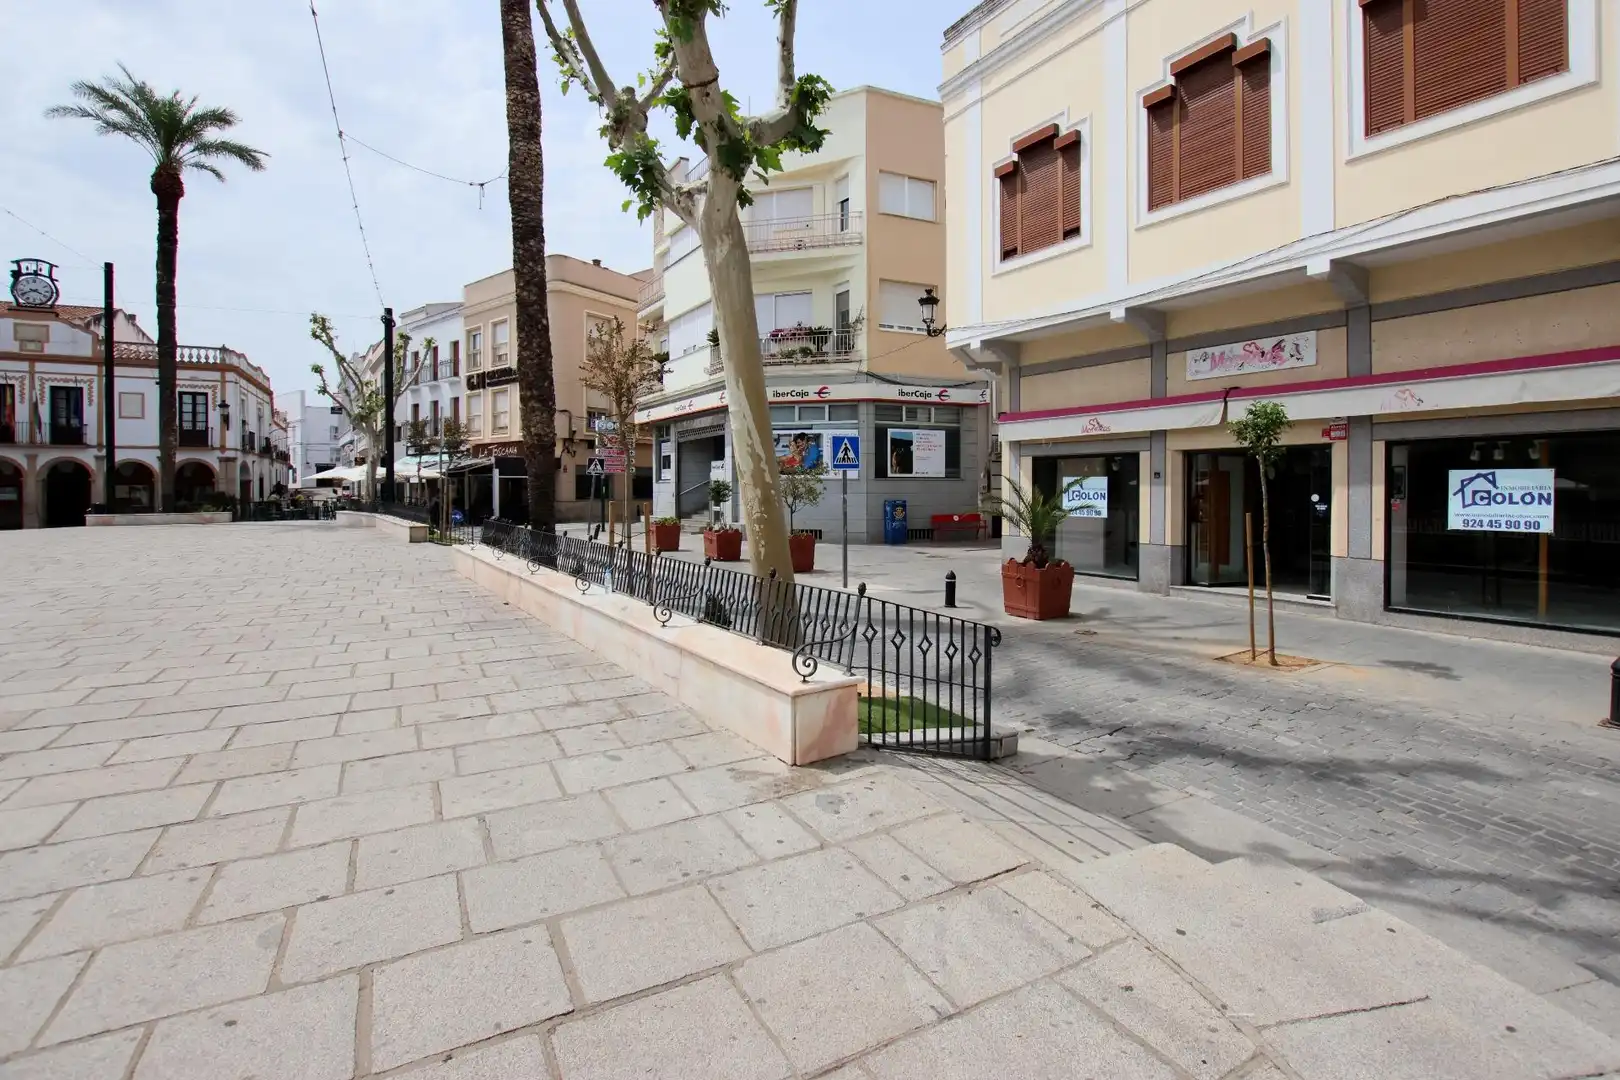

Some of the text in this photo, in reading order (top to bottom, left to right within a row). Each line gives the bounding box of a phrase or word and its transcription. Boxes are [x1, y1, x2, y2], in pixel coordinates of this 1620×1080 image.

[772, 390, 809, 398] iberCaja
[898, 389, 932, 398] iberCaja
[1472, 490, 1552, 506] COLÓN
[1462, 519, 1540, 530] 924 45 90 90
